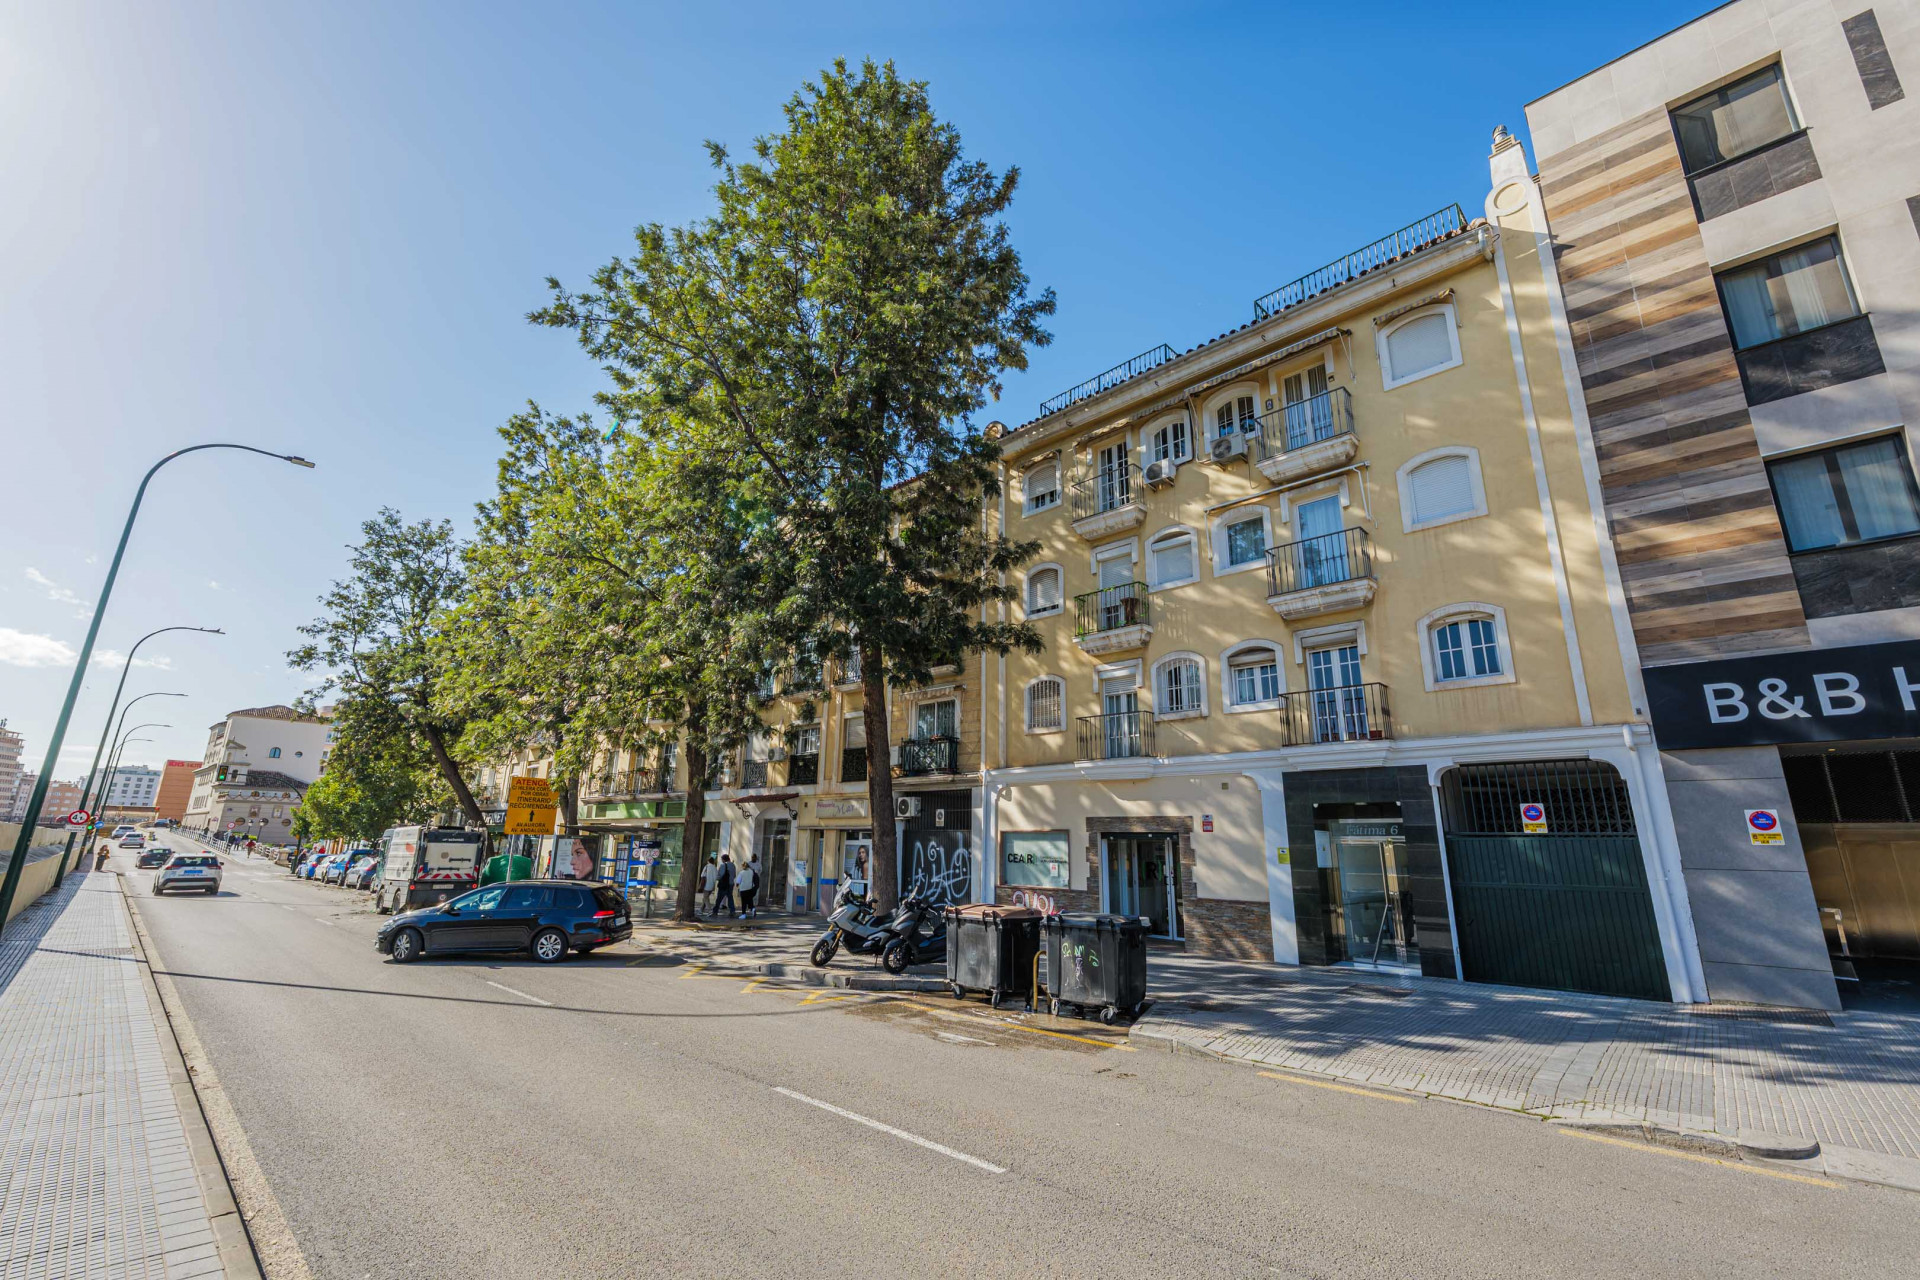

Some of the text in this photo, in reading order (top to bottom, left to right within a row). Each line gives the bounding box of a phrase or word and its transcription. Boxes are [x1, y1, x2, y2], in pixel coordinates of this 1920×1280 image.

[1703, 672, 1866, 723] B&B
[1346, 825, 1399, 835] Fátima 6
